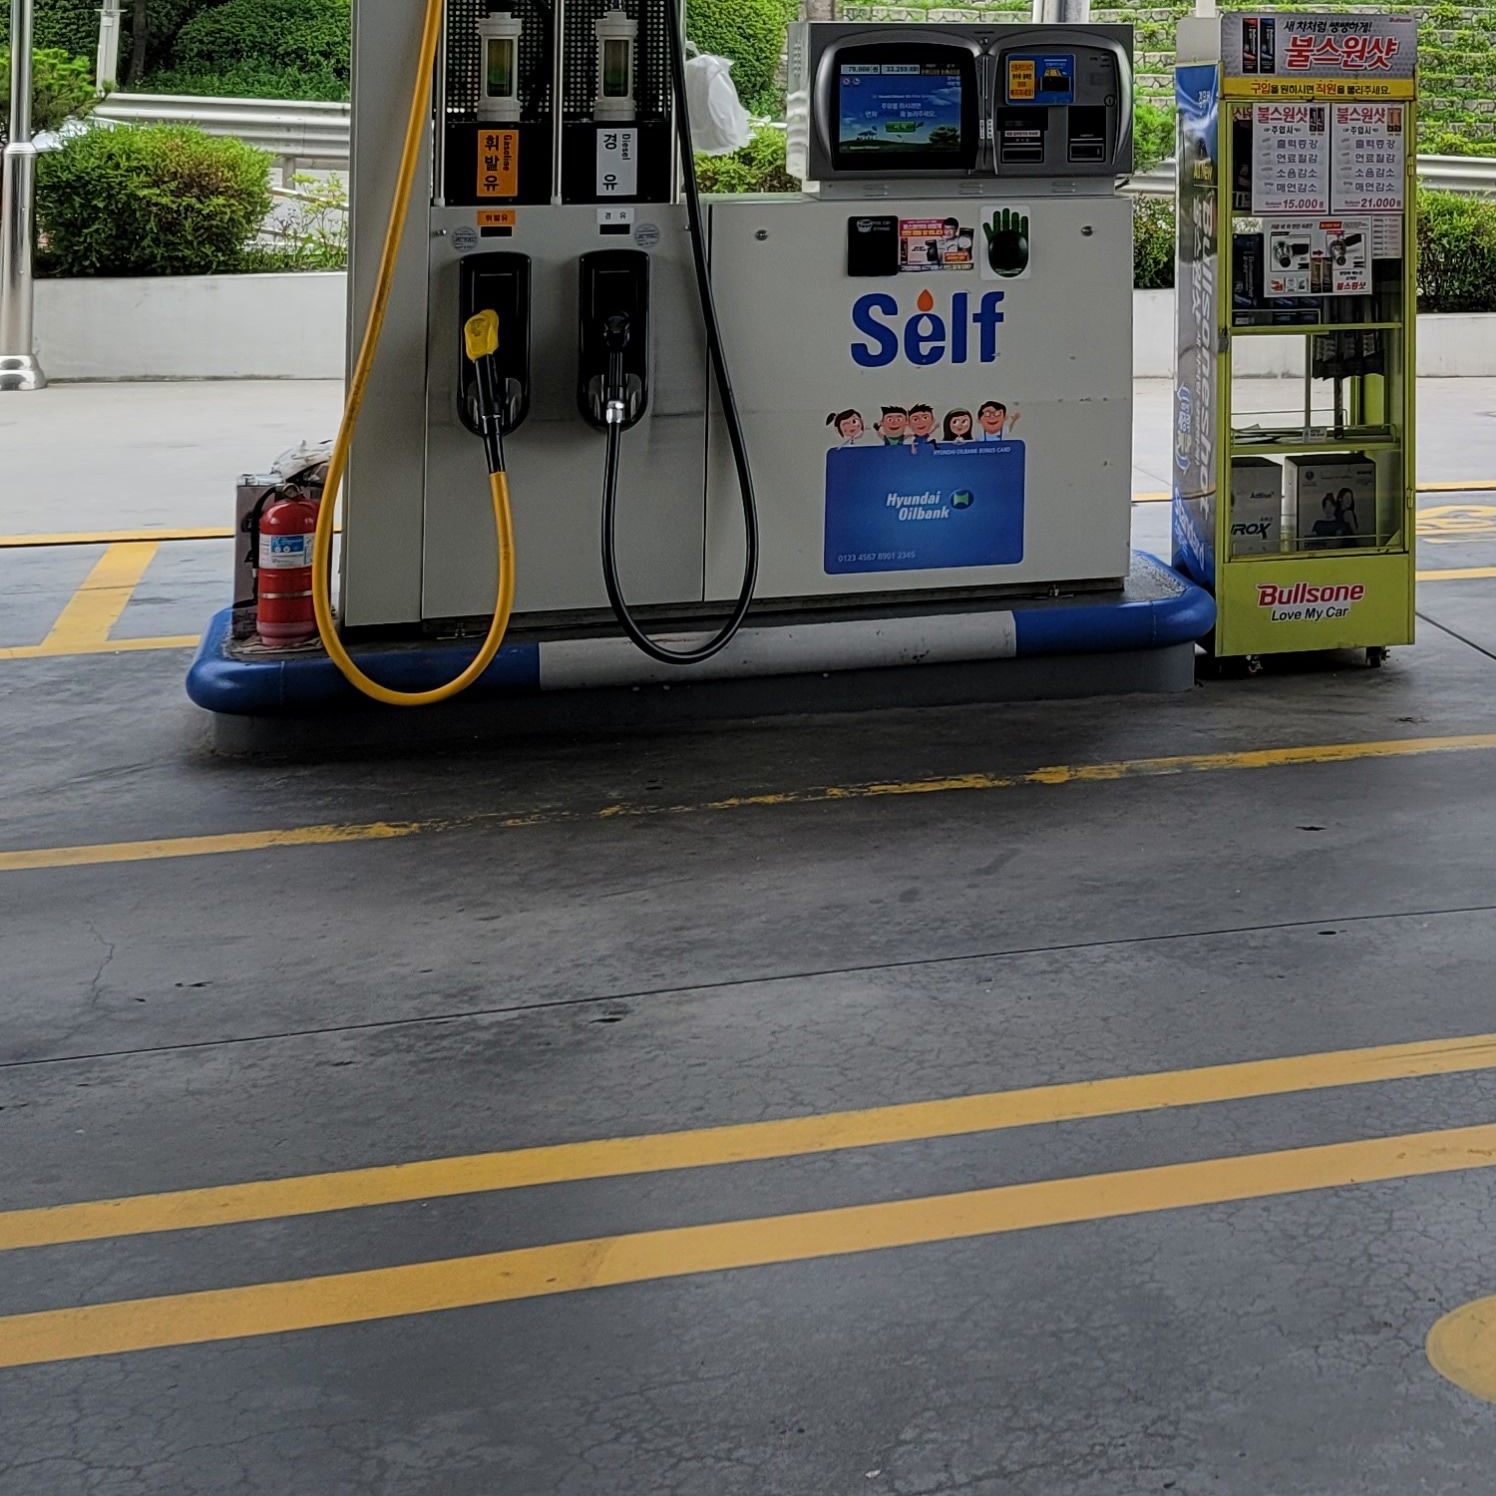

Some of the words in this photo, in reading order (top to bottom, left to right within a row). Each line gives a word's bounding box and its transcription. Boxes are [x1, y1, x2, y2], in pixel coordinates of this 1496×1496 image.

[1284, 21, 1295, 32] 새
[1296, 21, 1328, 32] 차처럼
[1284, 35, 1398, 70] 불스원샷
[1251, 83, 1278, 94] 구입을
[1281, 84, 1314, 94] 원하시면
[1316, 83, 1344, 94] 직원을
[1257, 106, 1307, 124] 불스원샷
[1337, 107, 1386, 124] 불스원샷
[503, 135, 512, 171] Gasoline
[621, 134, 631, 161] Diesel
[484, 135, 500, 192] 휘발유
[602, 133, 618, 191] 경유
[850, 289, 1005, 367] Self
[886, 491, 940, 507] Hyundai
[898, 507, 949, 521] Oilbank
[1257, 582, 1364, 607] Bullsone
[1272, 608, 1302, 622] Love
[1306, 608, 1324, 622] My
[1325, 606, 1349, 618] Car
